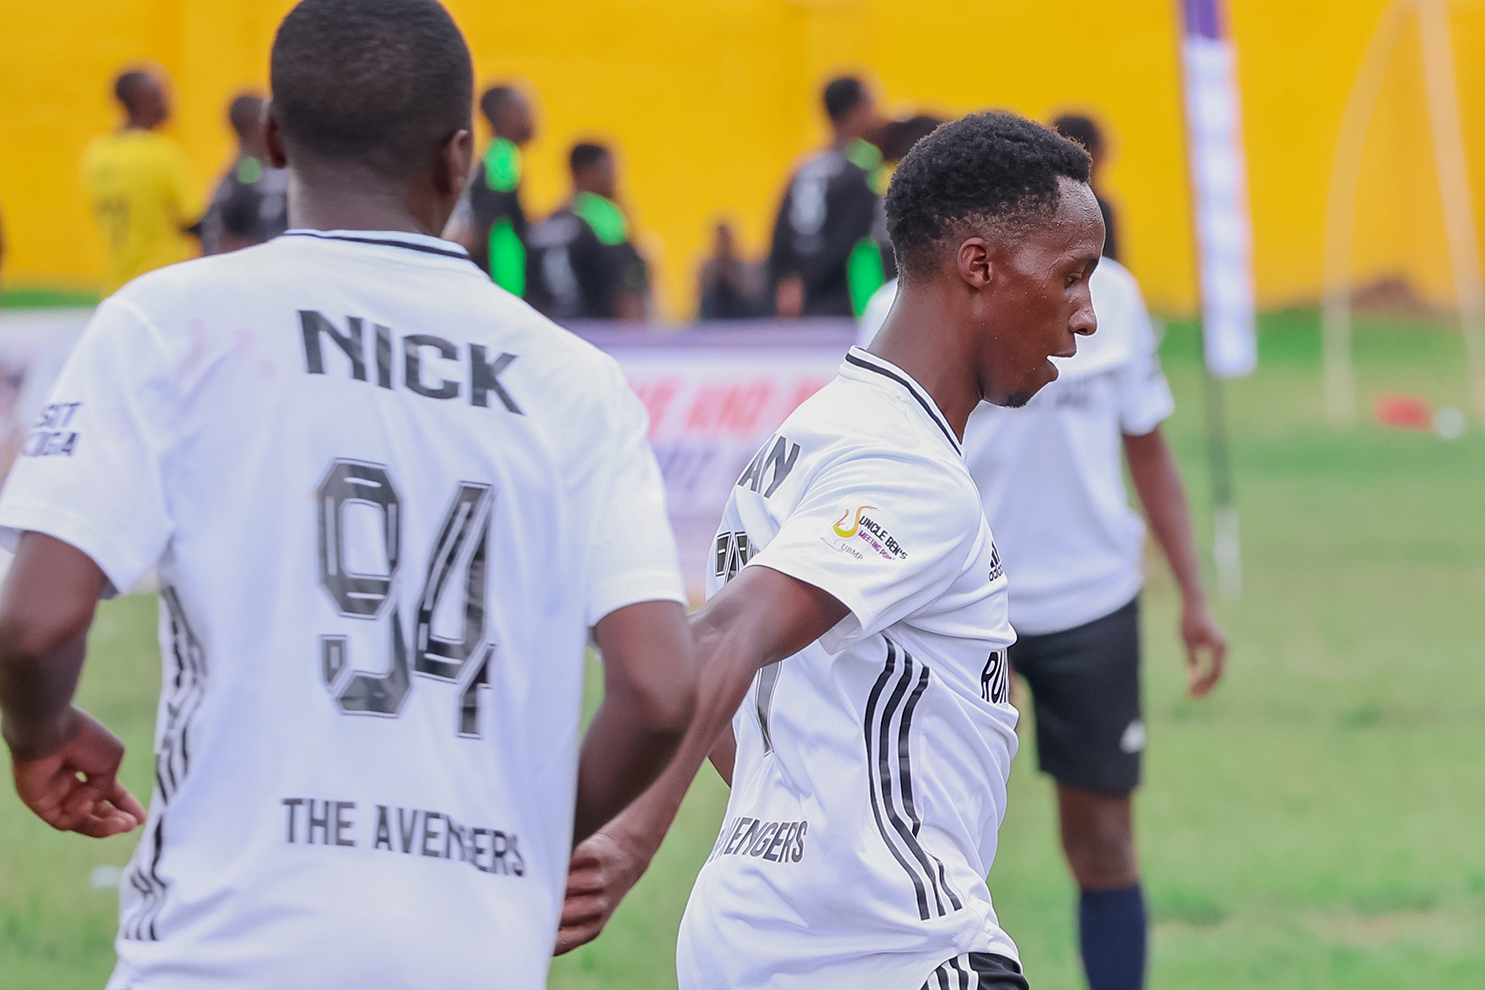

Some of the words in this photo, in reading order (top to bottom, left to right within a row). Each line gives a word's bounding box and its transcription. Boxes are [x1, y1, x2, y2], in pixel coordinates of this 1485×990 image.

[297, 309, 525, 416] NICK
[840, 543, 864, 560] UBMP
[858, 515, 888, 541] UNCLE
[884, 535, 908, 560] BEN'S
[858, 529, 882, 552] MEETING
[316, 456, 499, 741] 94
[281, 797, 357, 848] THE
[373, 803, 528, 878] AVENGERS
